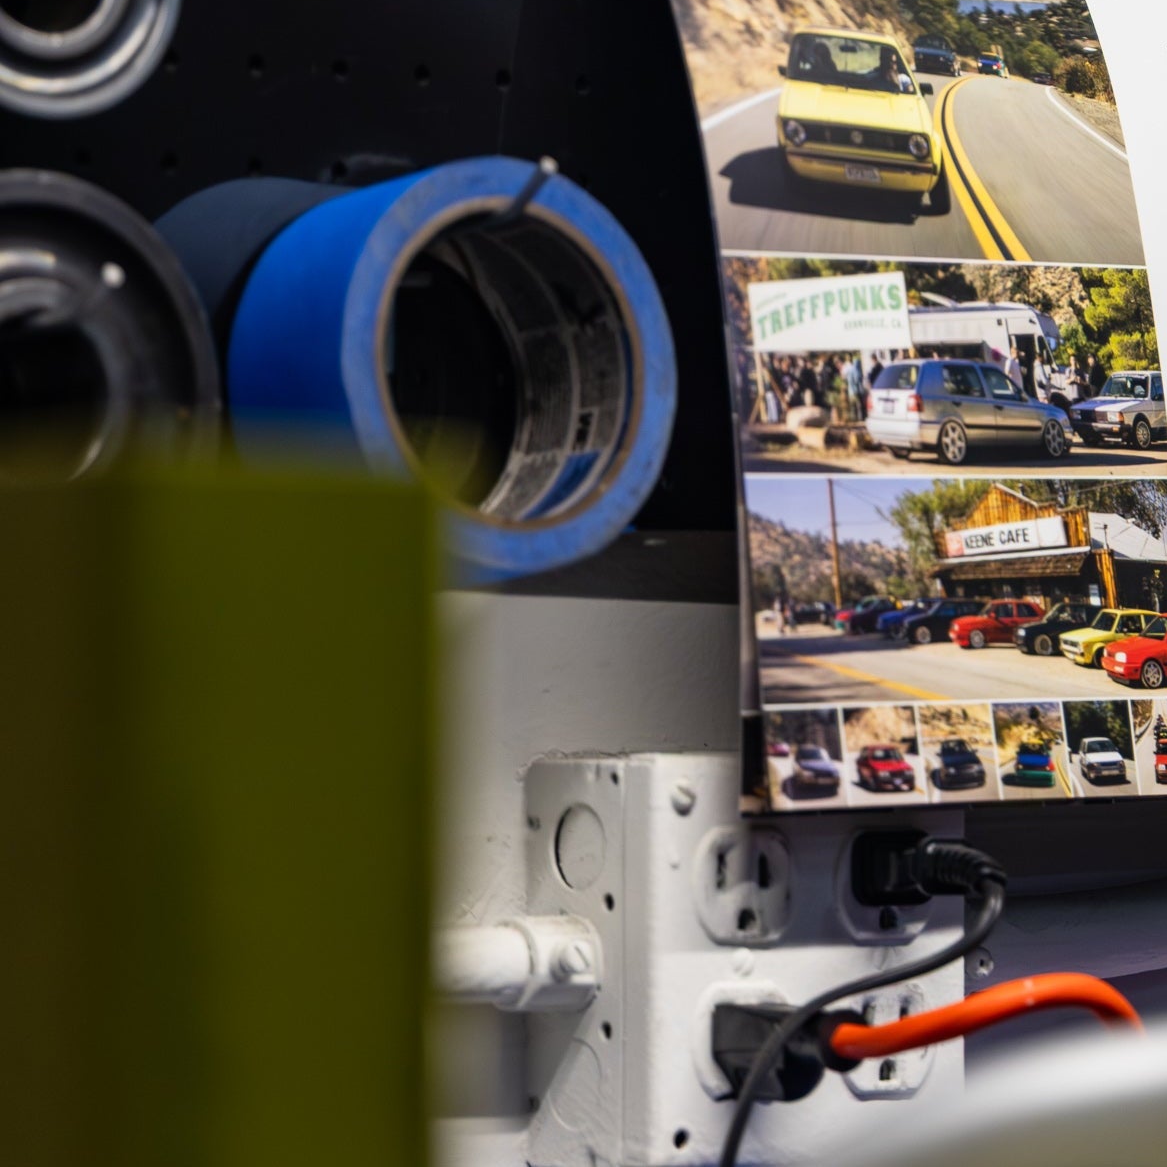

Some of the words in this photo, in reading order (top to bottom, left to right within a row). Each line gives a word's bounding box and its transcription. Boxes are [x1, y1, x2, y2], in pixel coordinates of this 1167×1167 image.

[757, 283, 903, 340] TREFFPUNKS
[964, 532, 995, 549] KEENE
[999, 527, 1030, 545] CAFE
